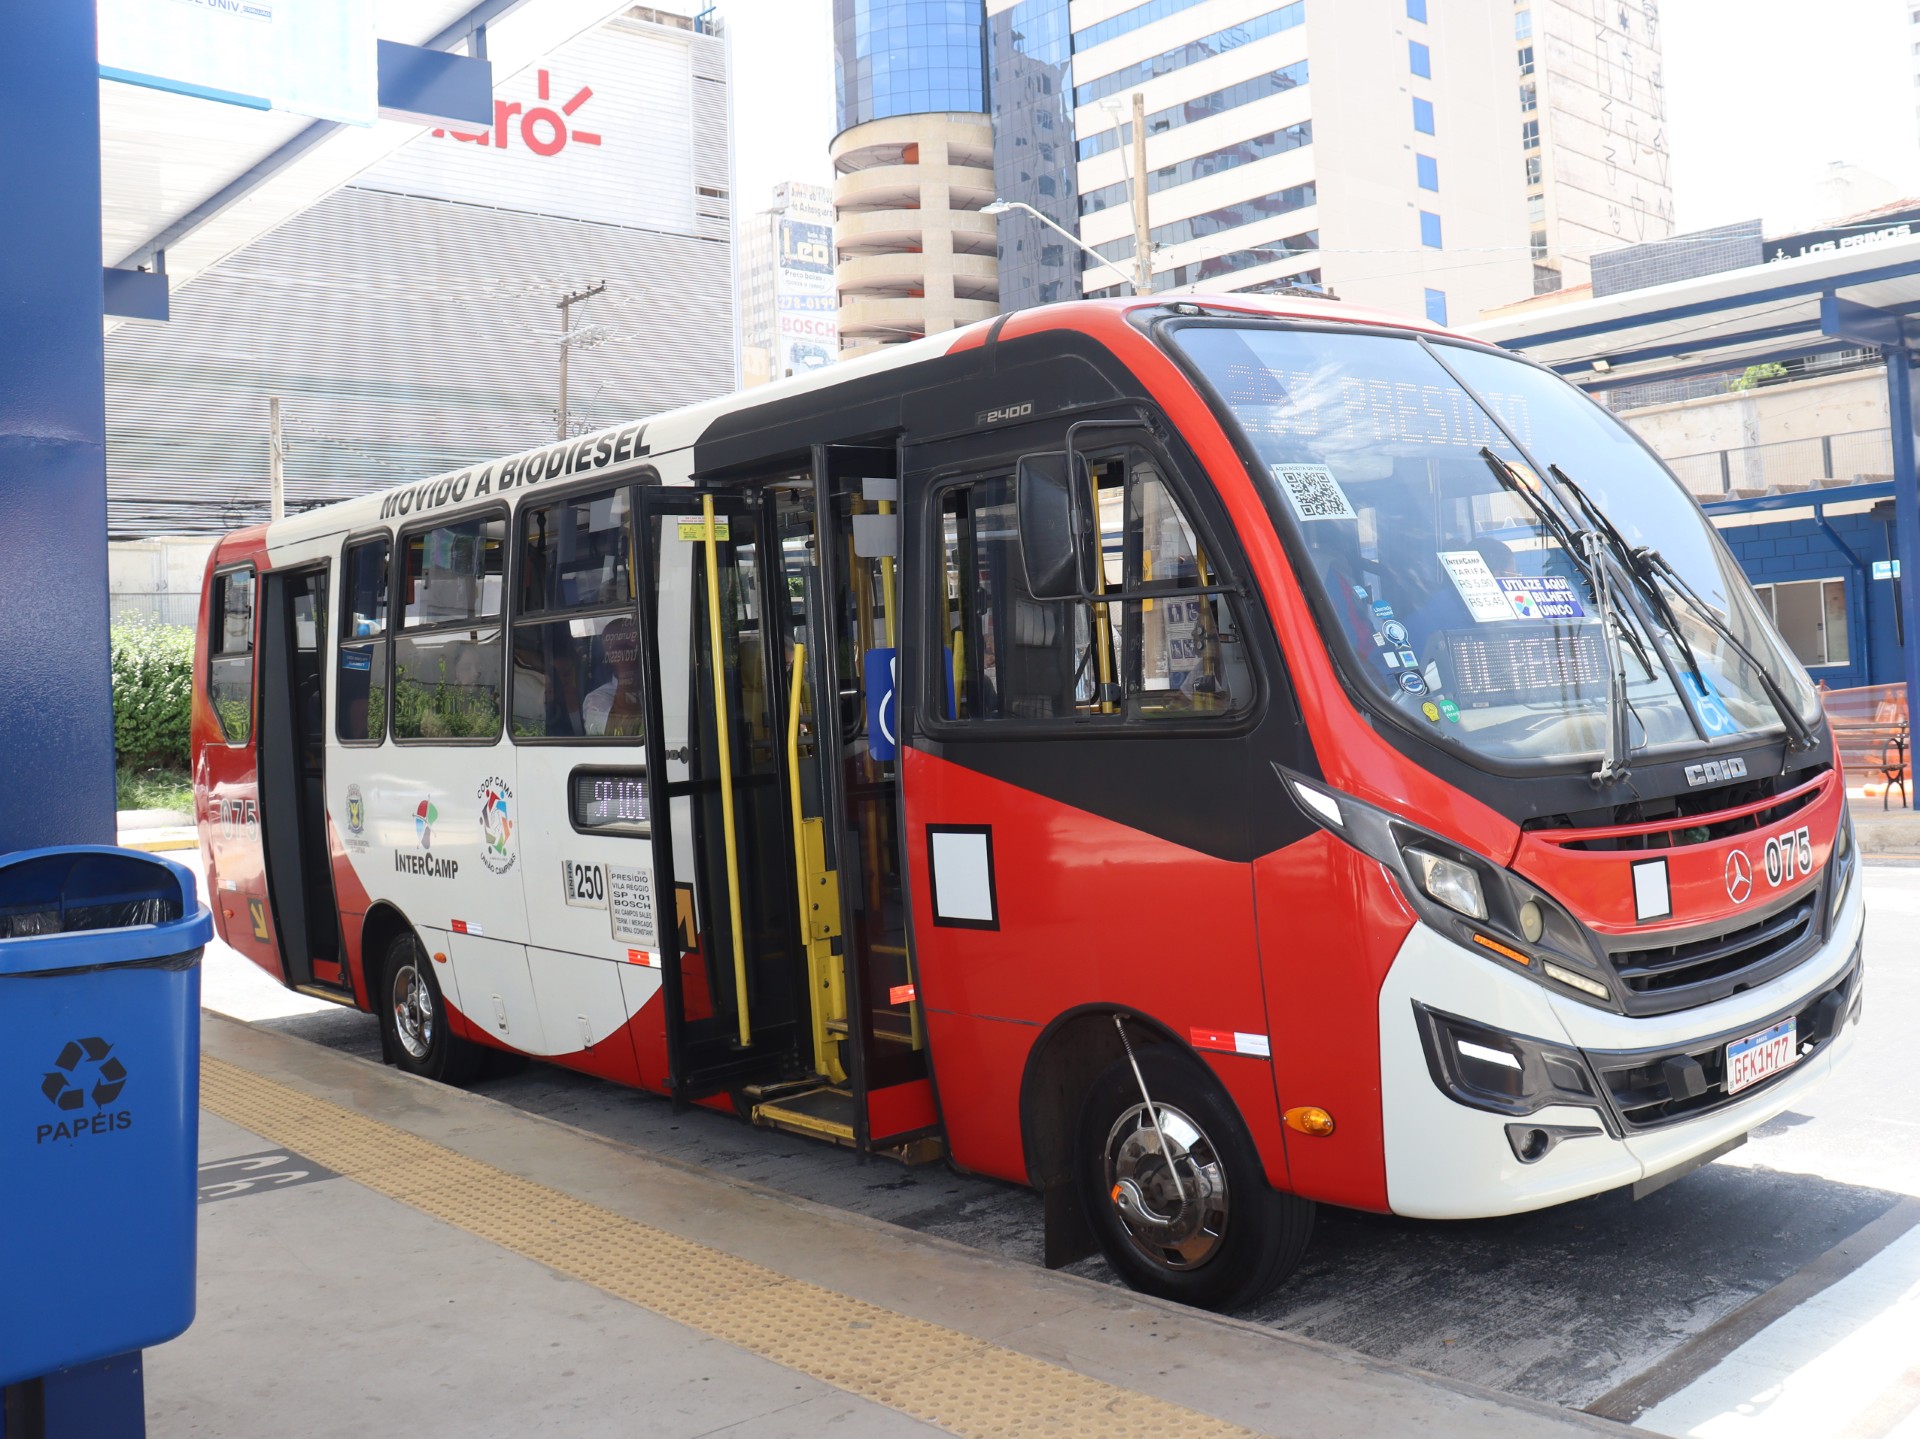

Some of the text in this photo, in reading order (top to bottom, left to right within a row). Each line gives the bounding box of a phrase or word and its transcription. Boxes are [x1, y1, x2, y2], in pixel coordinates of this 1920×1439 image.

[1800, 224, 1911, 260] LOS PRIMOS
[781, 316, 837, 338] BOSCH
[379, 423, 651, 520] MOVIDO A BIODIESEL
[1451, 568, 1486, 576] TARIFA
[1501, 578, 1570, 591] UTILIZE AQUI
[1531, 591, 1576, 602] BILHETE
[1538, 602, 1574, 616] ÚNICO
[1684, 757, 1748, 787] CAIO
[477, 776, 513, 799] COOP CAMP
[219, 797, 259, 843] 075
[494, 852, 516, 875] CAMPINAS
[1764, 825, 1813, 888] 075
[567, 862, 575, 897] LINHA
[575, 863, 604, 900] 250
[611, 873, 648, 883] PRESÍDIO
[612, 882, 625, 890] VILA
[613, 890, 651, 902] SP 101
[614, 899, 651, 910] BOSCH
[621, 909, 639, 918] CAMPOS
[639, 911, 652, 920] SALES
[1734, 1036, 1789, 1085] GFK1H77
[36, 1109, 132, 1144] PAPÉIS
